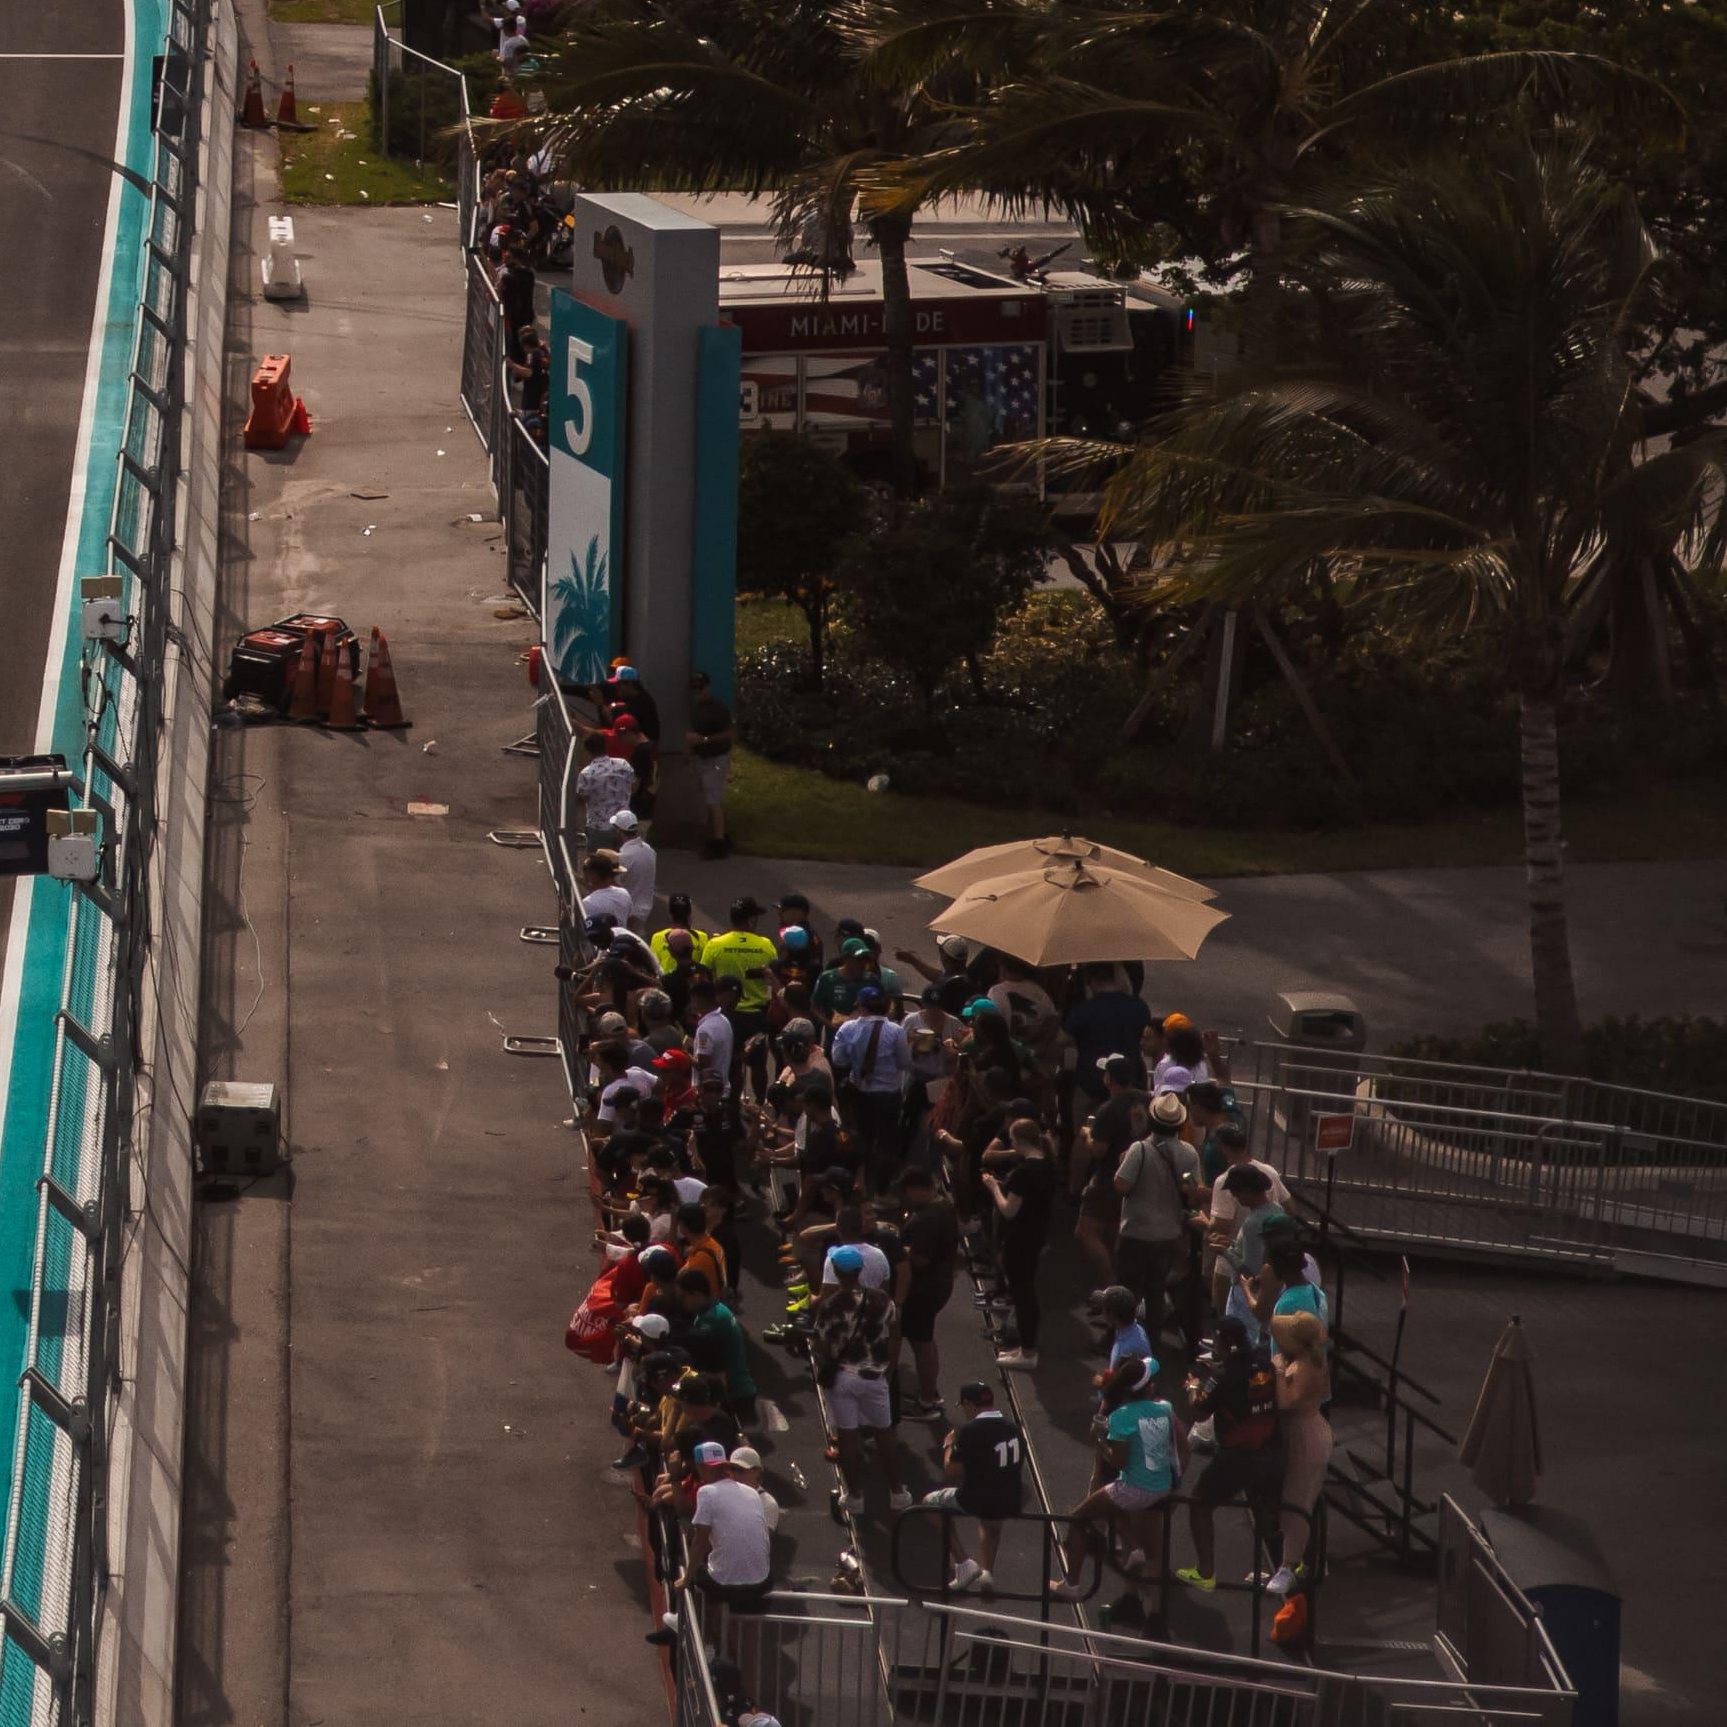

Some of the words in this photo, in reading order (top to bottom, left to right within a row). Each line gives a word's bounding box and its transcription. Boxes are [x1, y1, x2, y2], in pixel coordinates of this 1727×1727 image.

[790, 311, 946, 337] MIAMI-DE
[564, 335, 595, 455] 5
[994, 1437, 1020, 1467] 11
